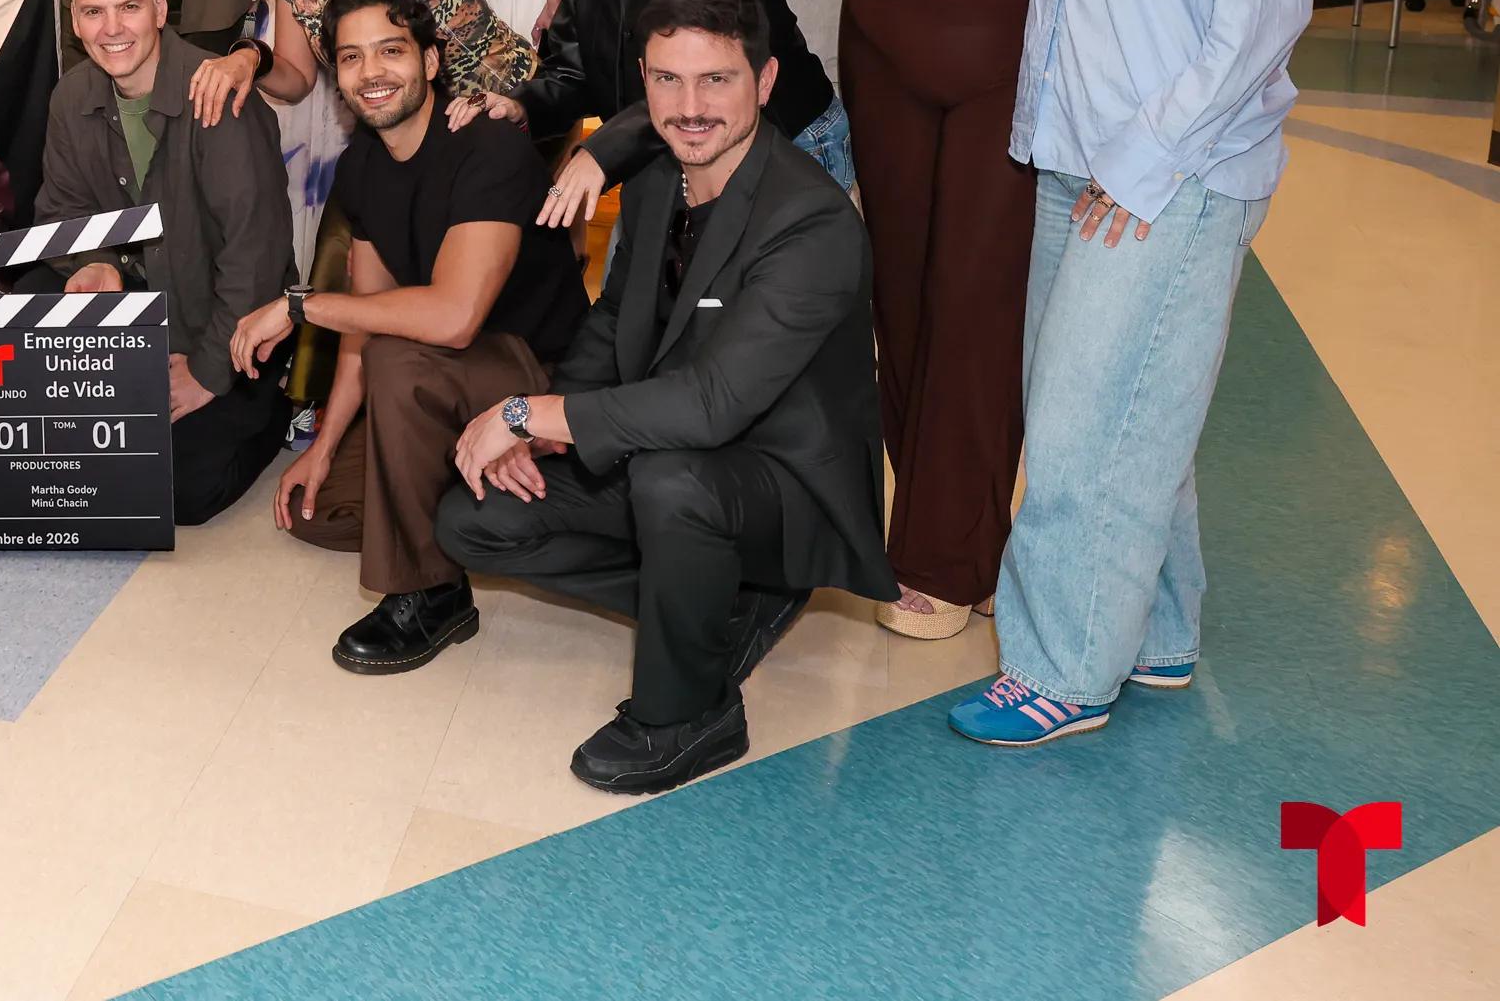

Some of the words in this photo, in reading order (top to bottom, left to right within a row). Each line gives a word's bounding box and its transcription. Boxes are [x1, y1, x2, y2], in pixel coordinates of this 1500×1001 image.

[25, 332, 151, 353] Emergencias.
[46, 355, 113, 371] Unidad
[46, 381, 69, 397] de
[73, 381, 114, 397] Vida
[93, 421, 125, 448] 01
[11, 461, 80, 470] PRODUCTORES
[32, 485, 64, 494] Martha
[67, 485, 97, 495] Godoy
[32, 499, 54, 507] Minú
[57, 498, 88, 507] Chacin
[28, 533, 42, 544] de
[47, 533, 79, 544] 2026
